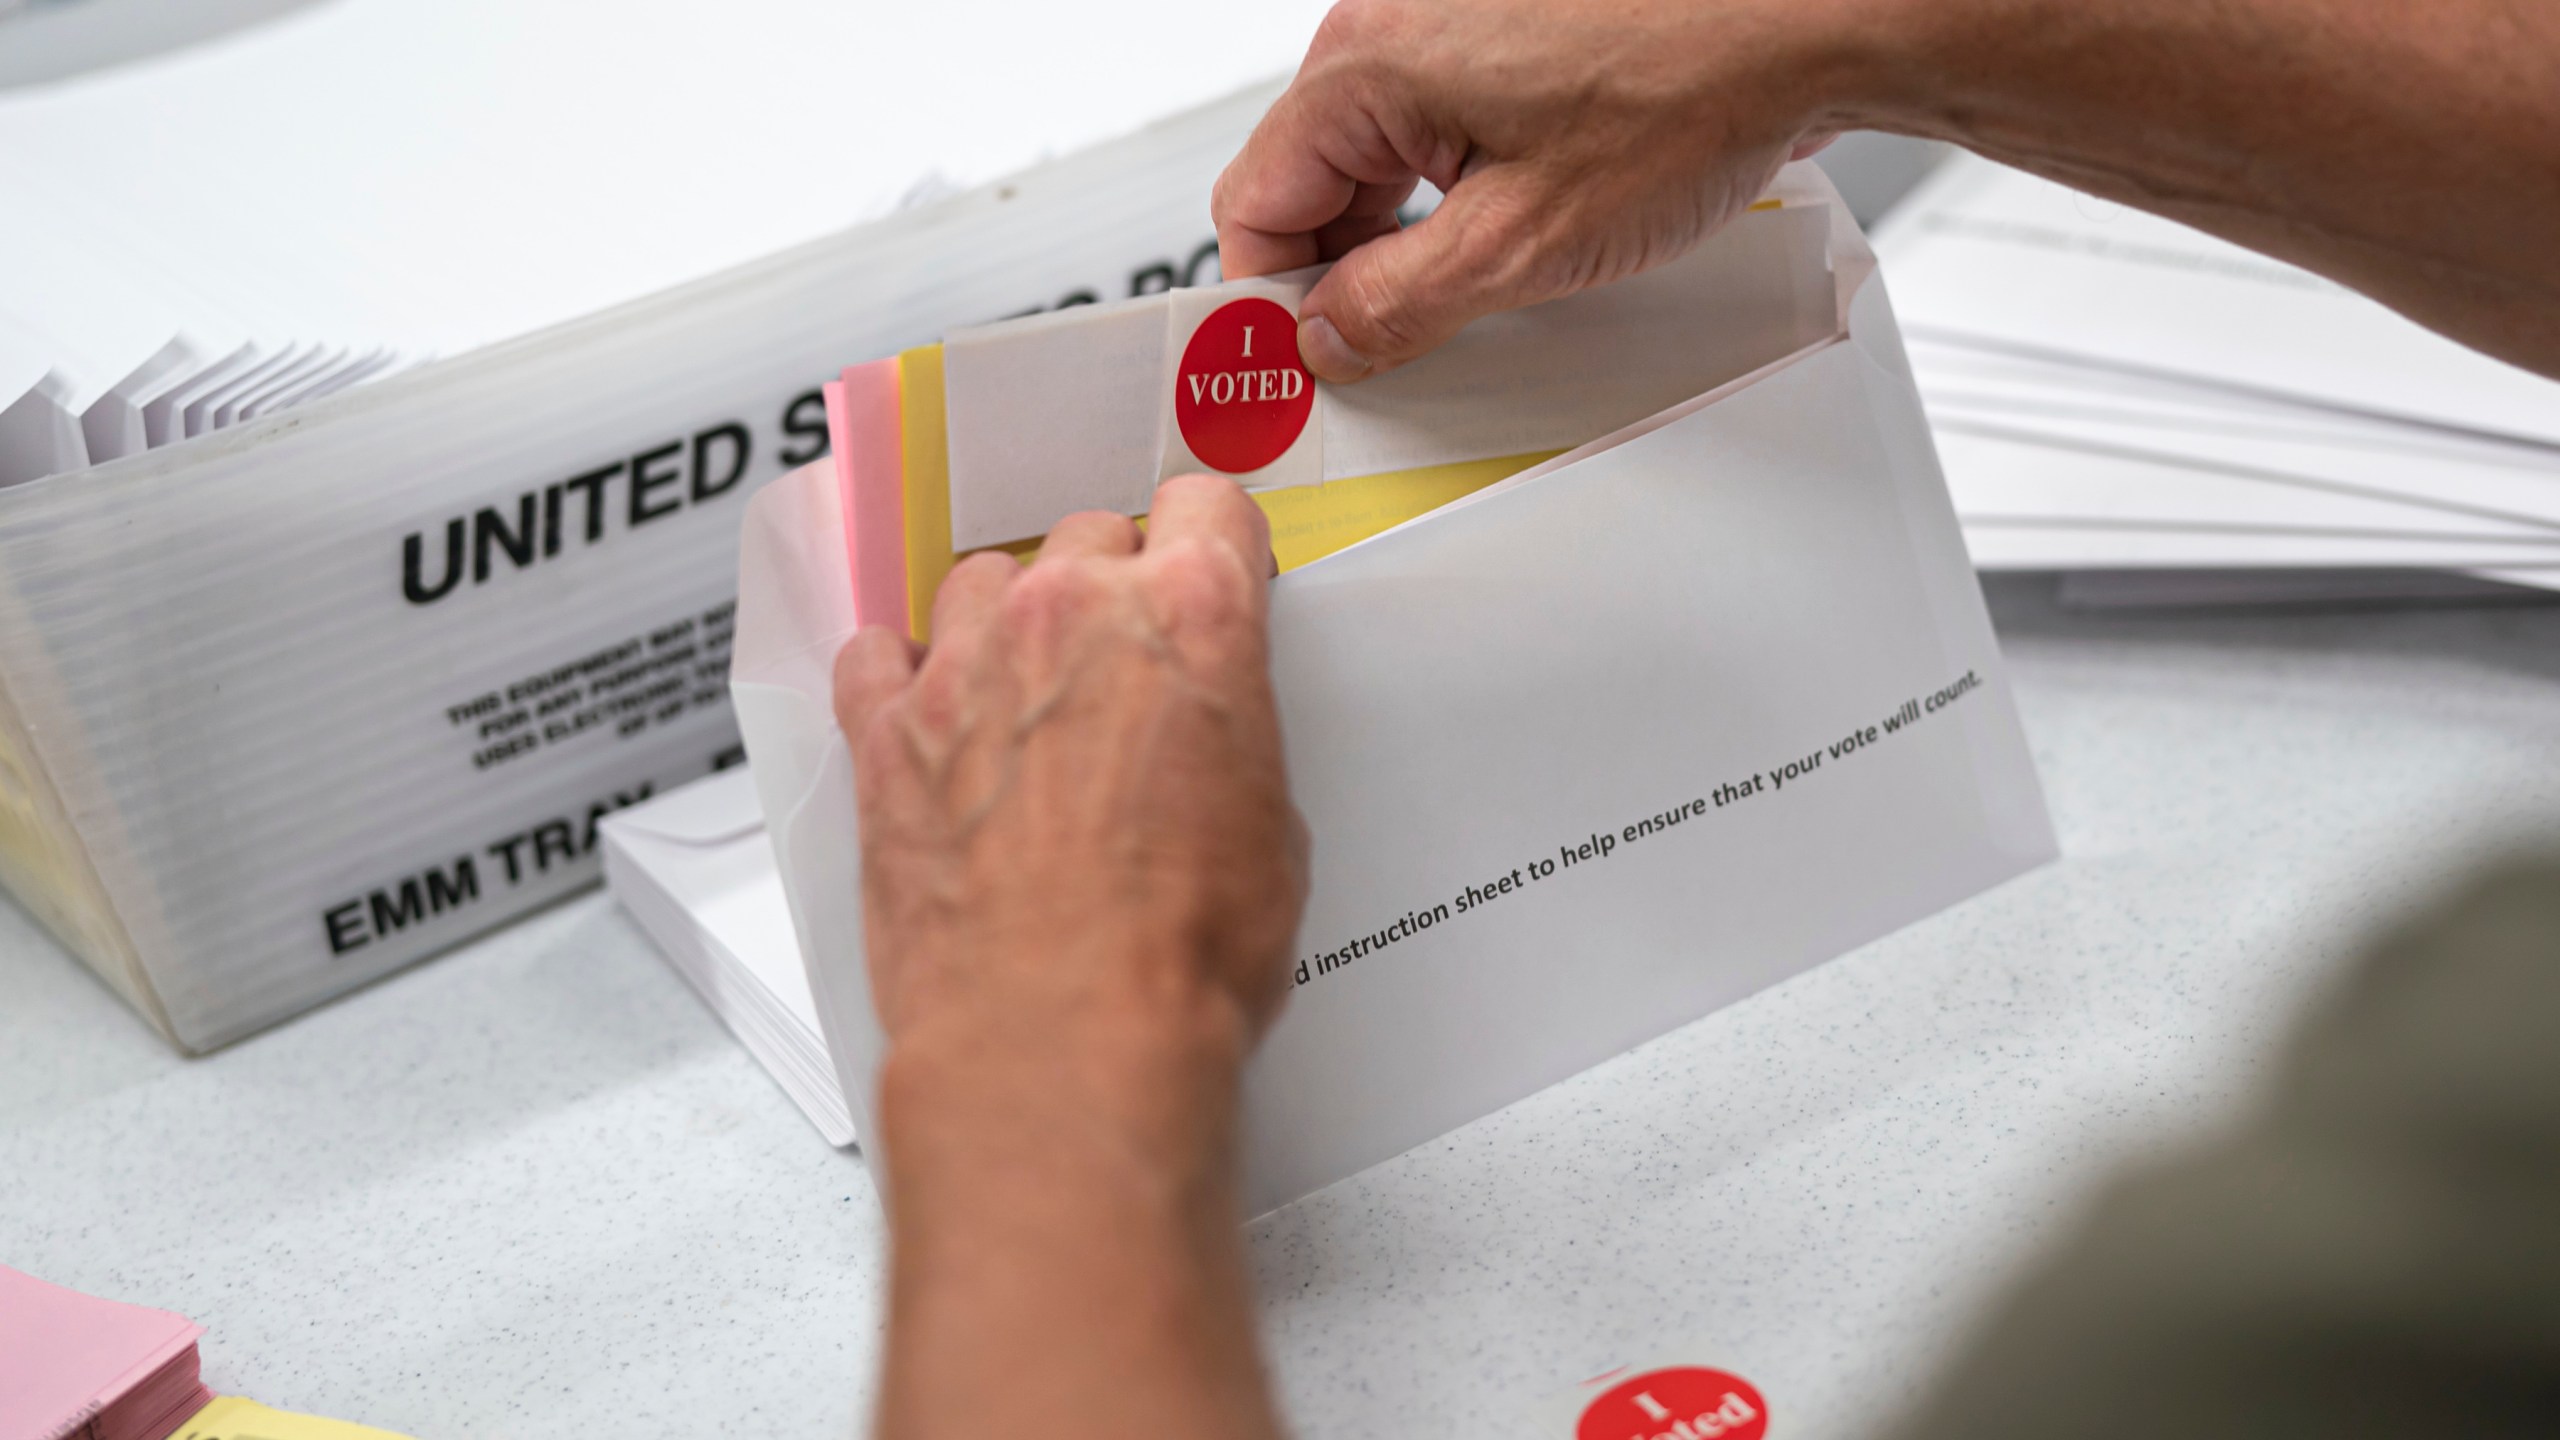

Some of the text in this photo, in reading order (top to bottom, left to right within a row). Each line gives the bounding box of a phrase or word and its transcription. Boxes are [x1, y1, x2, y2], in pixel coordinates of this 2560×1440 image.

[1241, 325, 1255, 358] I
[1187, 367, 1305, 407] VOTED
[402, 420, 752, 606] UNITED
[1314, 903, 1449, 976] instruction
[1455, 868, 1524, 913] sheet
[1528, 858, 1555, 881] to
[1560, 832, 1616, 869] help
[1622, 798, 1707, 843] ensure
[1712, 773, 1764, 808] that
[1769, 750, 1822, 789] your
[1828, 725, 1878, 760] vote
[1882, 698, 1921, 735] will
[1925, 669, 1983, 714] count.
[323, 852, 481, 956] EMM
[1629, 1391, 1758, 1440] ted
[1630, 1390, 1671, 1422] I
